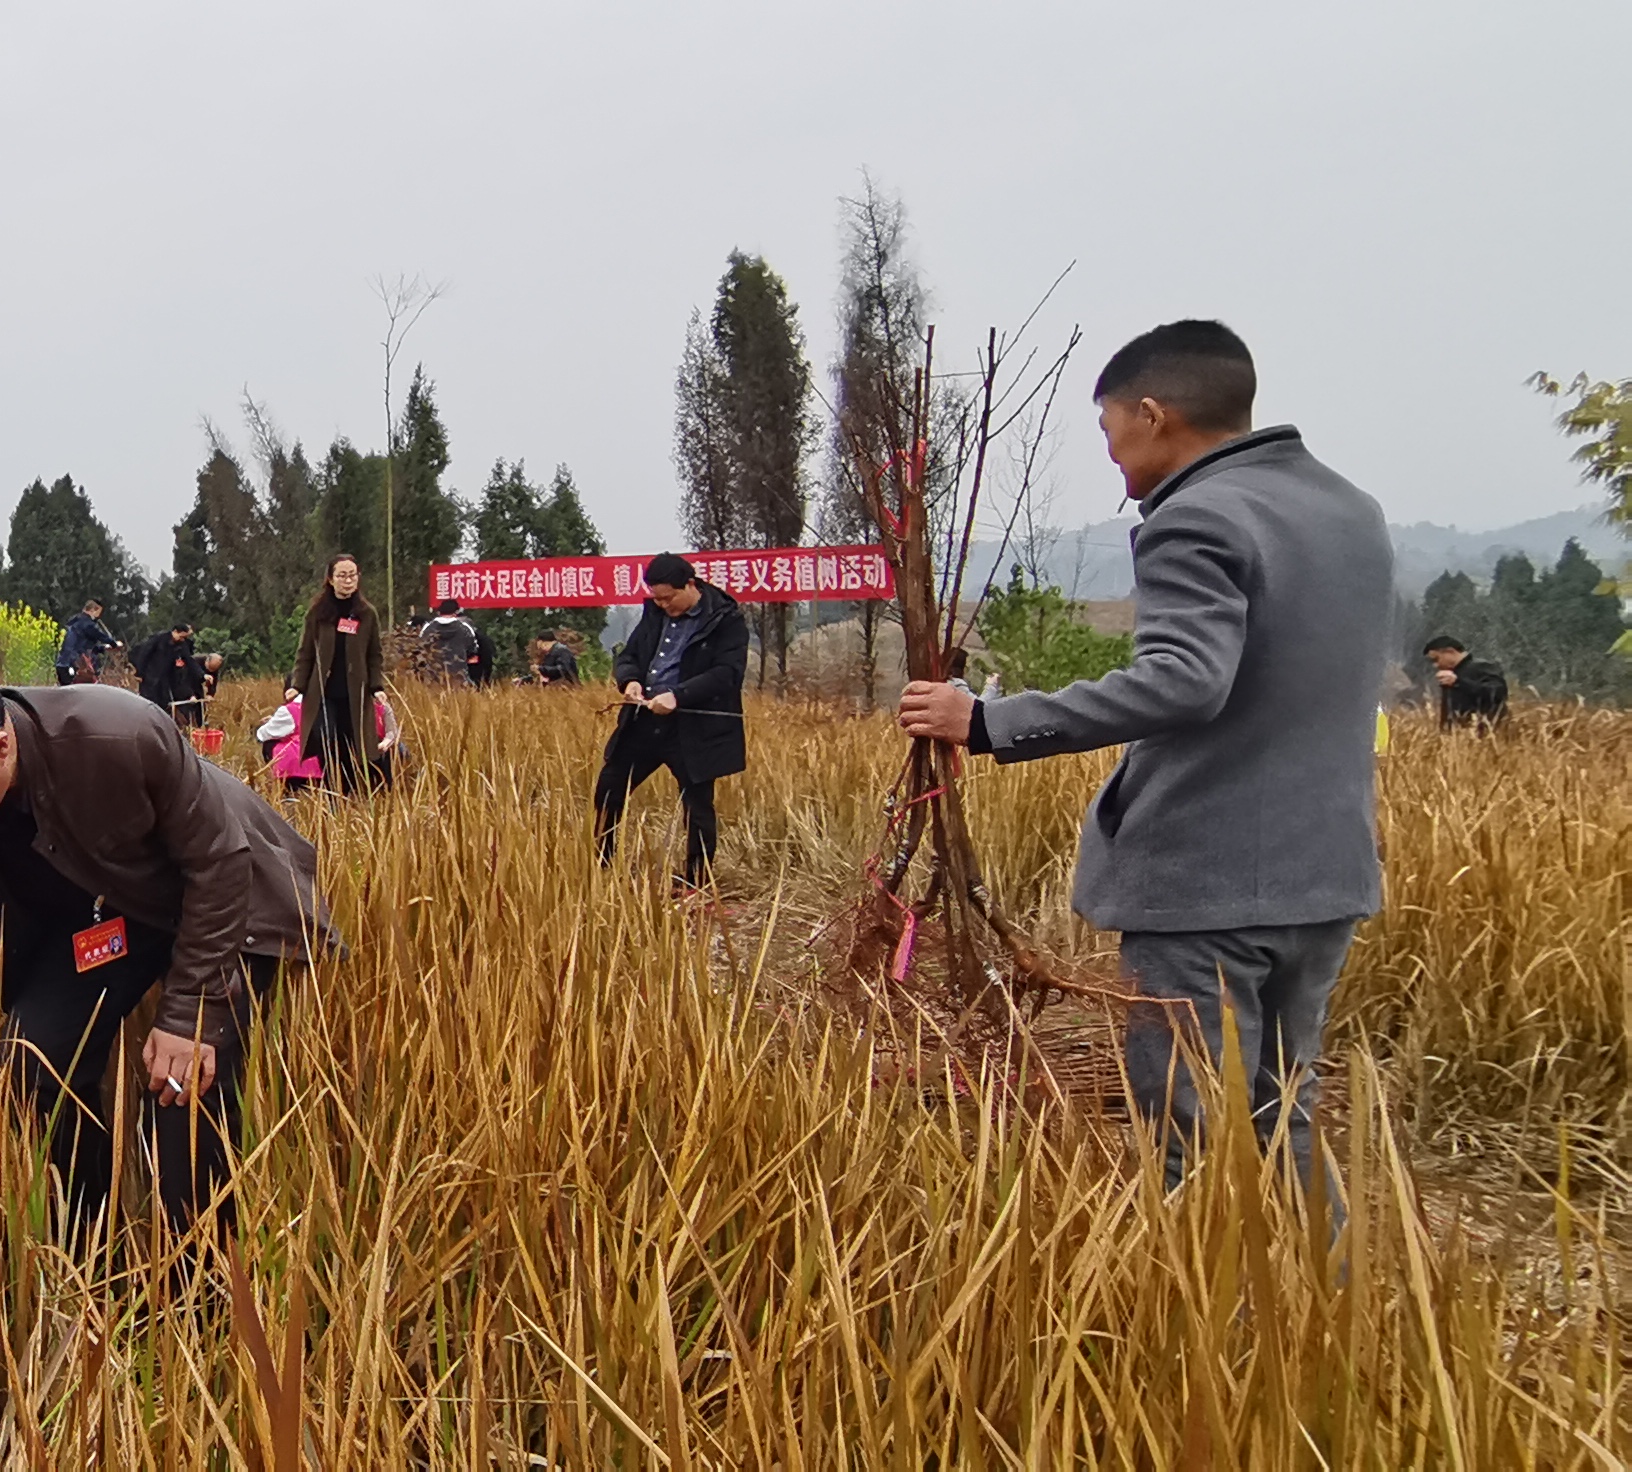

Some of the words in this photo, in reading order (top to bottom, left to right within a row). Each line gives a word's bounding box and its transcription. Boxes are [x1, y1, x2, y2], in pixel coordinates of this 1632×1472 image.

[435, 554, 886, 600] 重庆市大足区金山镇区、镇人春季义务植树活动
